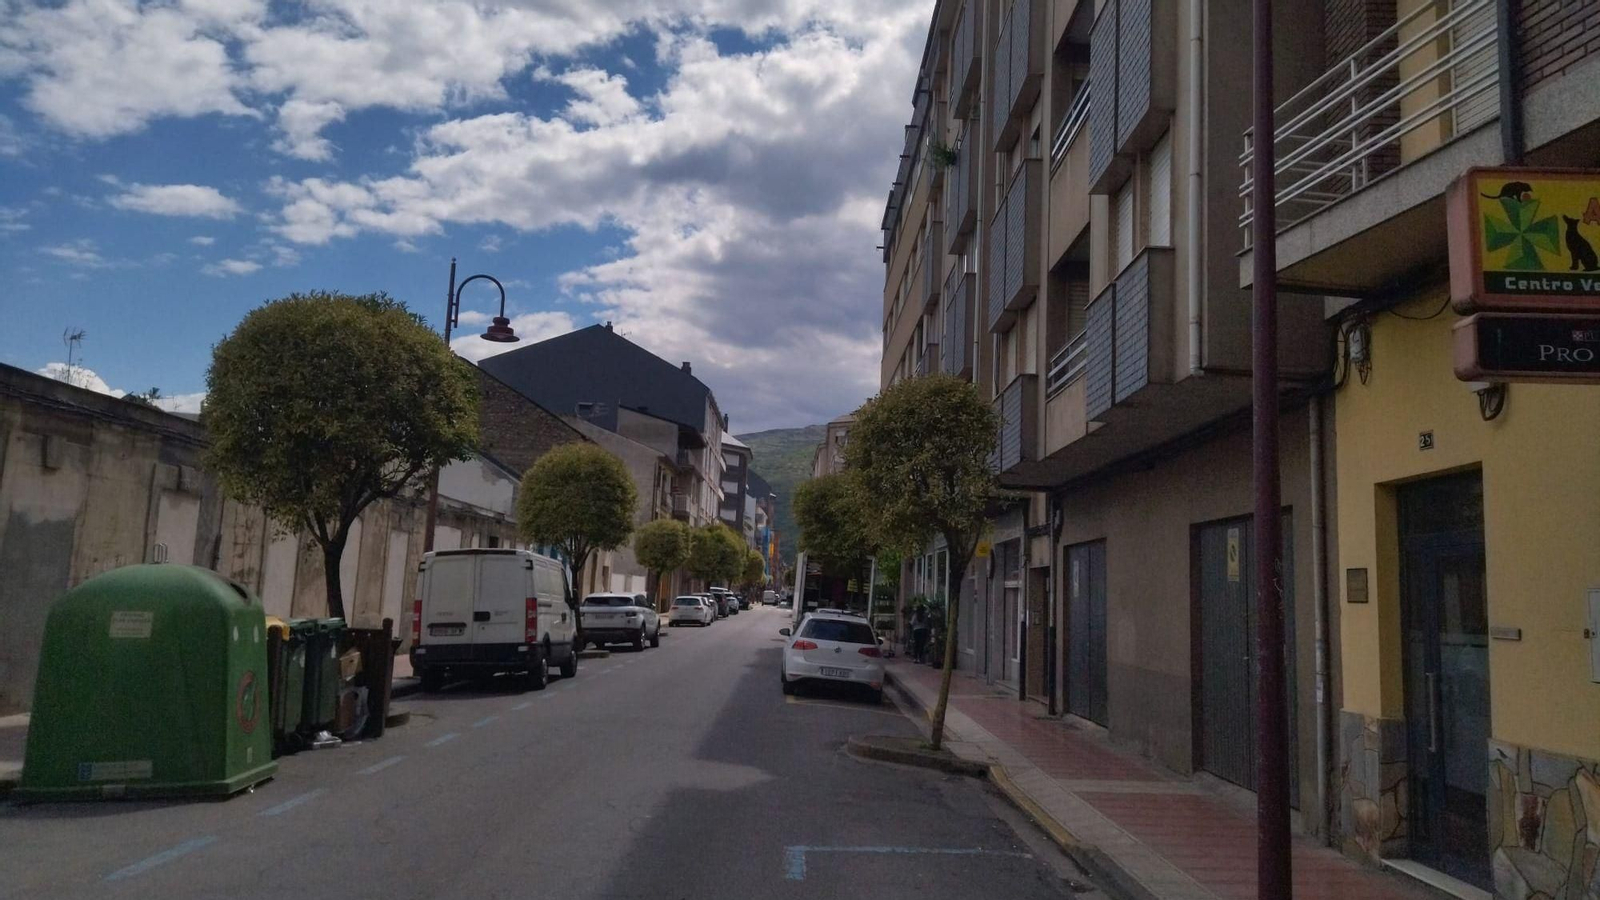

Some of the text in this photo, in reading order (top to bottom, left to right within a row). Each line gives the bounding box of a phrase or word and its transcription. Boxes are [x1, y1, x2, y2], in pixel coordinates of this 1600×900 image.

[1505, 277, 1574, 291] Centro
[1538, 344, 1594, 362] PRO
[1420, 434, 1431, 447] 25
